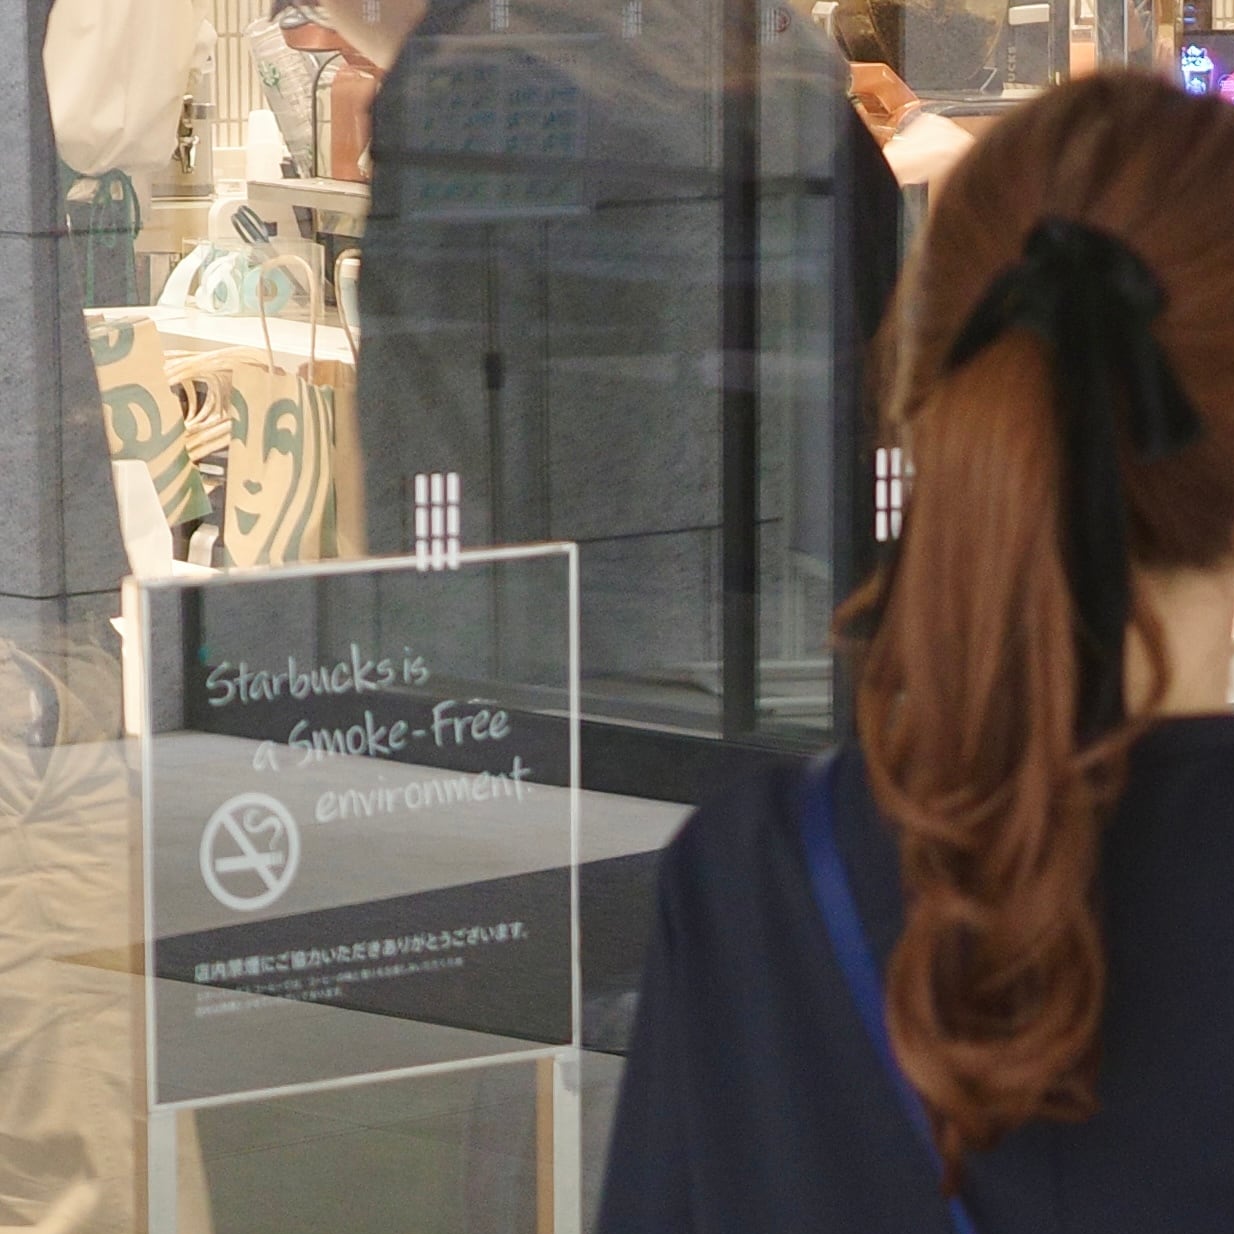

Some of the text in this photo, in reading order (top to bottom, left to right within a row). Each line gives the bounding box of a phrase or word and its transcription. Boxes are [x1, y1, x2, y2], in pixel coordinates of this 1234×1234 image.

[207, 644, 428, 705] Starbucks is
[252, 701, 511, 772] a Smoke-Free
[315, 756, 532, 823] environment.
